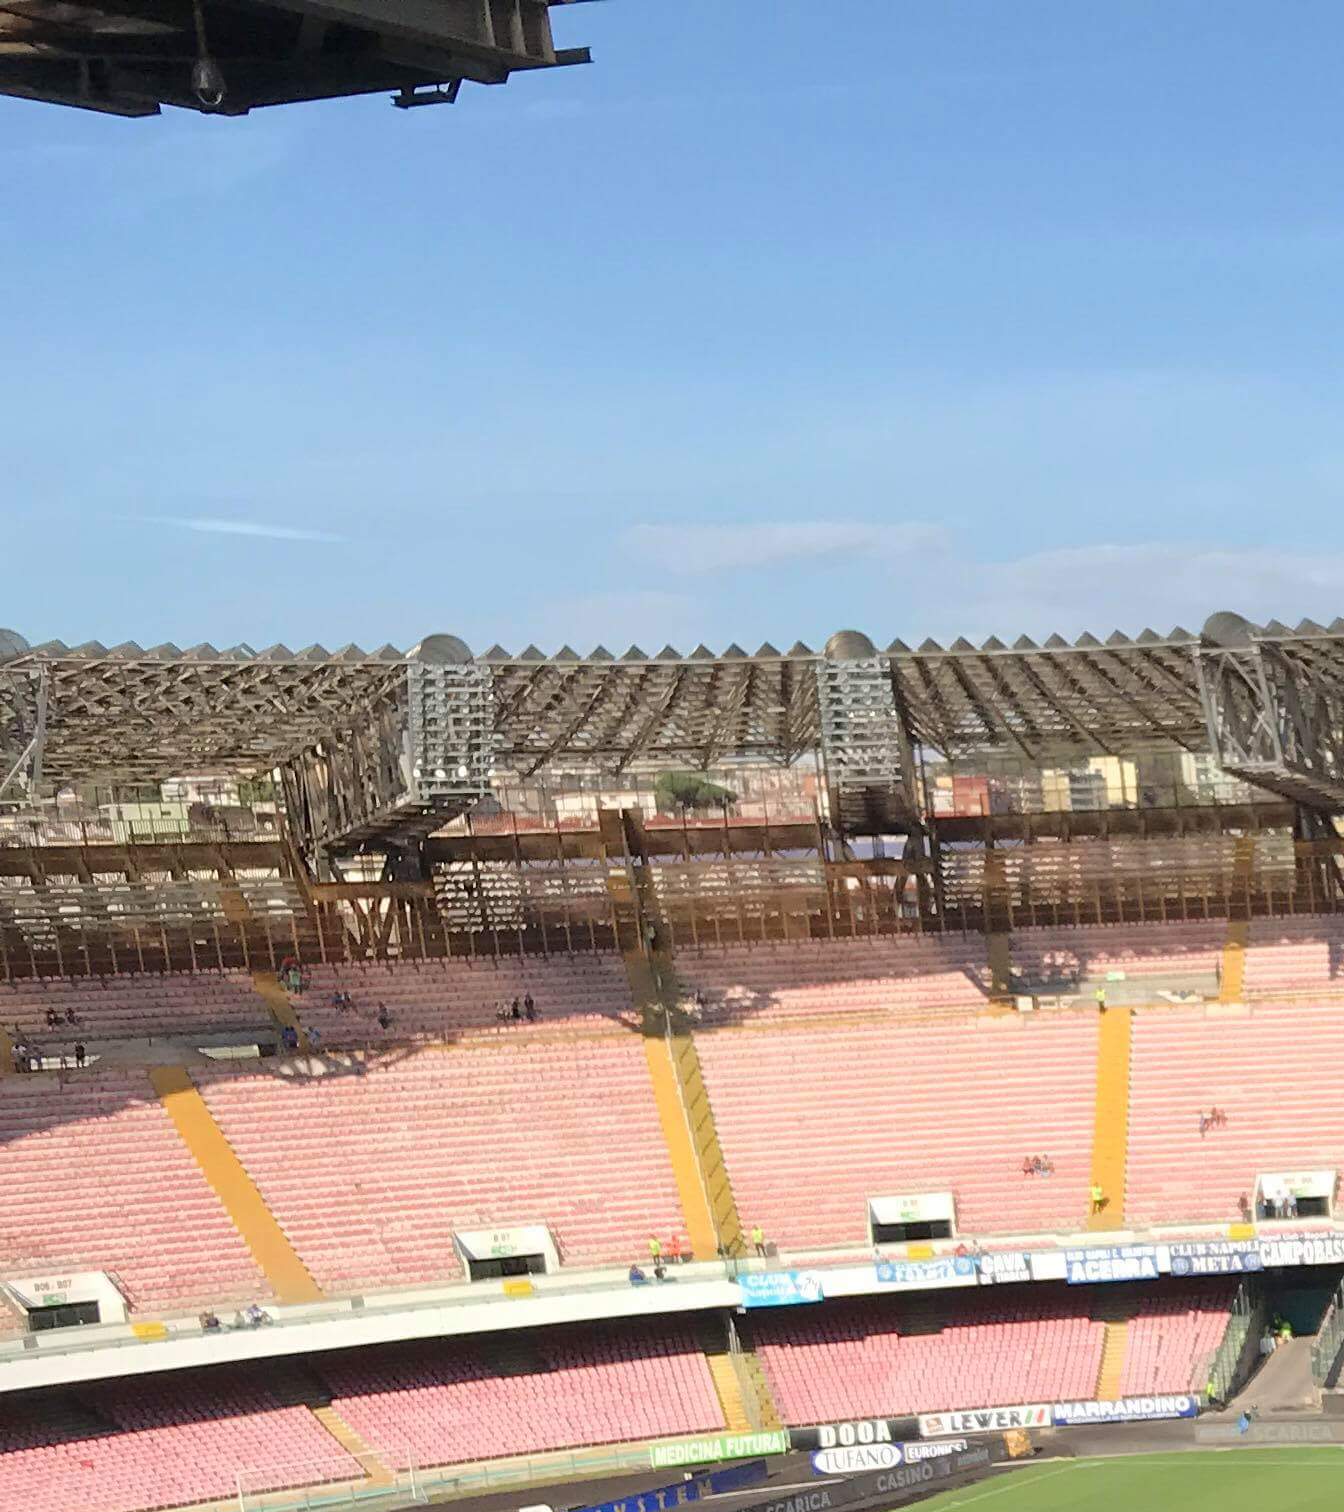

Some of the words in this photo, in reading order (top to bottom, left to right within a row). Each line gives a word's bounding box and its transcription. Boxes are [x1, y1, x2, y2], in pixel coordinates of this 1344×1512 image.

[1193, 1255, 1243, 1272] META
[949, 1405, 1022, 1432] LEWER
[1055, 1398, 1191, 1419] MARRANDINO
[654, 1438, 723, 1463] MEDICINA
[726, 1432, 782, 1455] FUTURA
[823, 1446, 895, 1472] TUFANO
